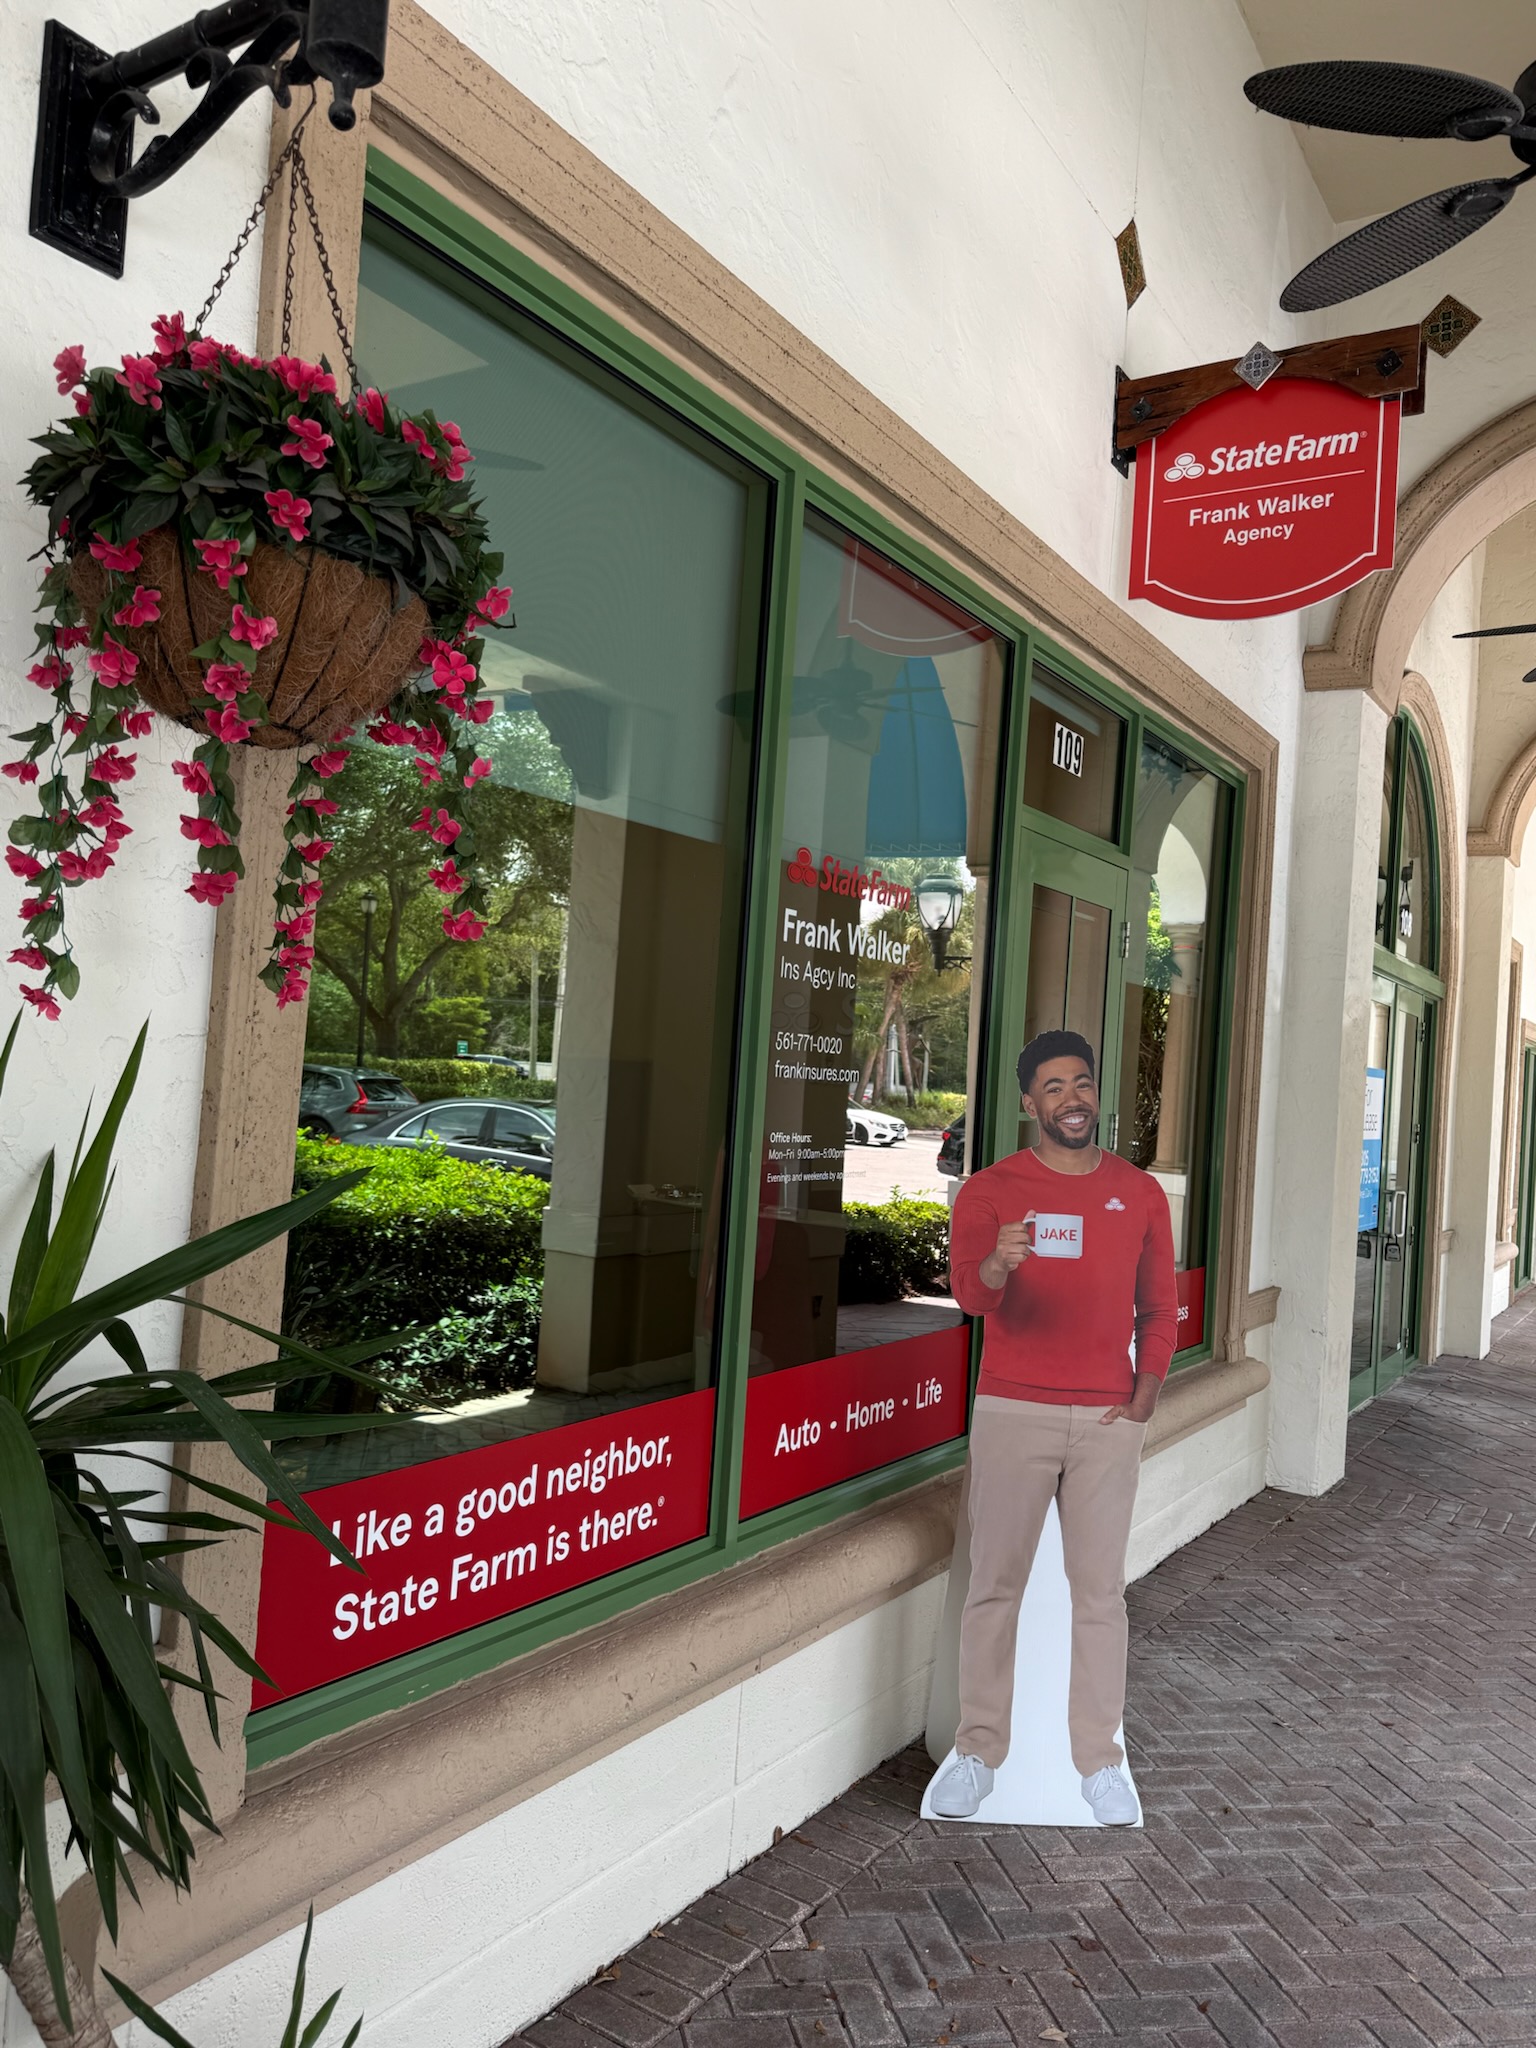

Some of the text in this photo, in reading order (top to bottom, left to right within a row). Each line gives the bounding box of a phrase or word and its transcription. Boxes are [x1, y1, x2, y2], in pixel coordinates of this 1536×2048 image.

[1189, 492, 1334, 527] Frank Walker
[1223, 523, 1294, 546] Agency
[1057, 727, 1082, 775] 109
[782, 907, 911, 966] Frank Walker
[780, 956, 800, 980] Ins
[802, 960, 835, 991] Agcy
[775, 1031, 843, 1055] 561-771-0020
[774, 1059, 860, 1083] frankinsures.com
[769, 1132, 812, 1143] Office Hours:
[791, 1173, 802, 1182] and
[1040, 1228, 1078, 1241] JAKE
[774, 1377, 942, 1457] Auto Home Life
[423, 1503, 444, 1539] a
[455, 1464, 538, 1538] good
[545, 1435, 673, 1500] neighbor,
[332, 1573, 439, 1641] State
[449, 1541, 537, 1602] Farm
[546, 1525, 570, 1566] is
